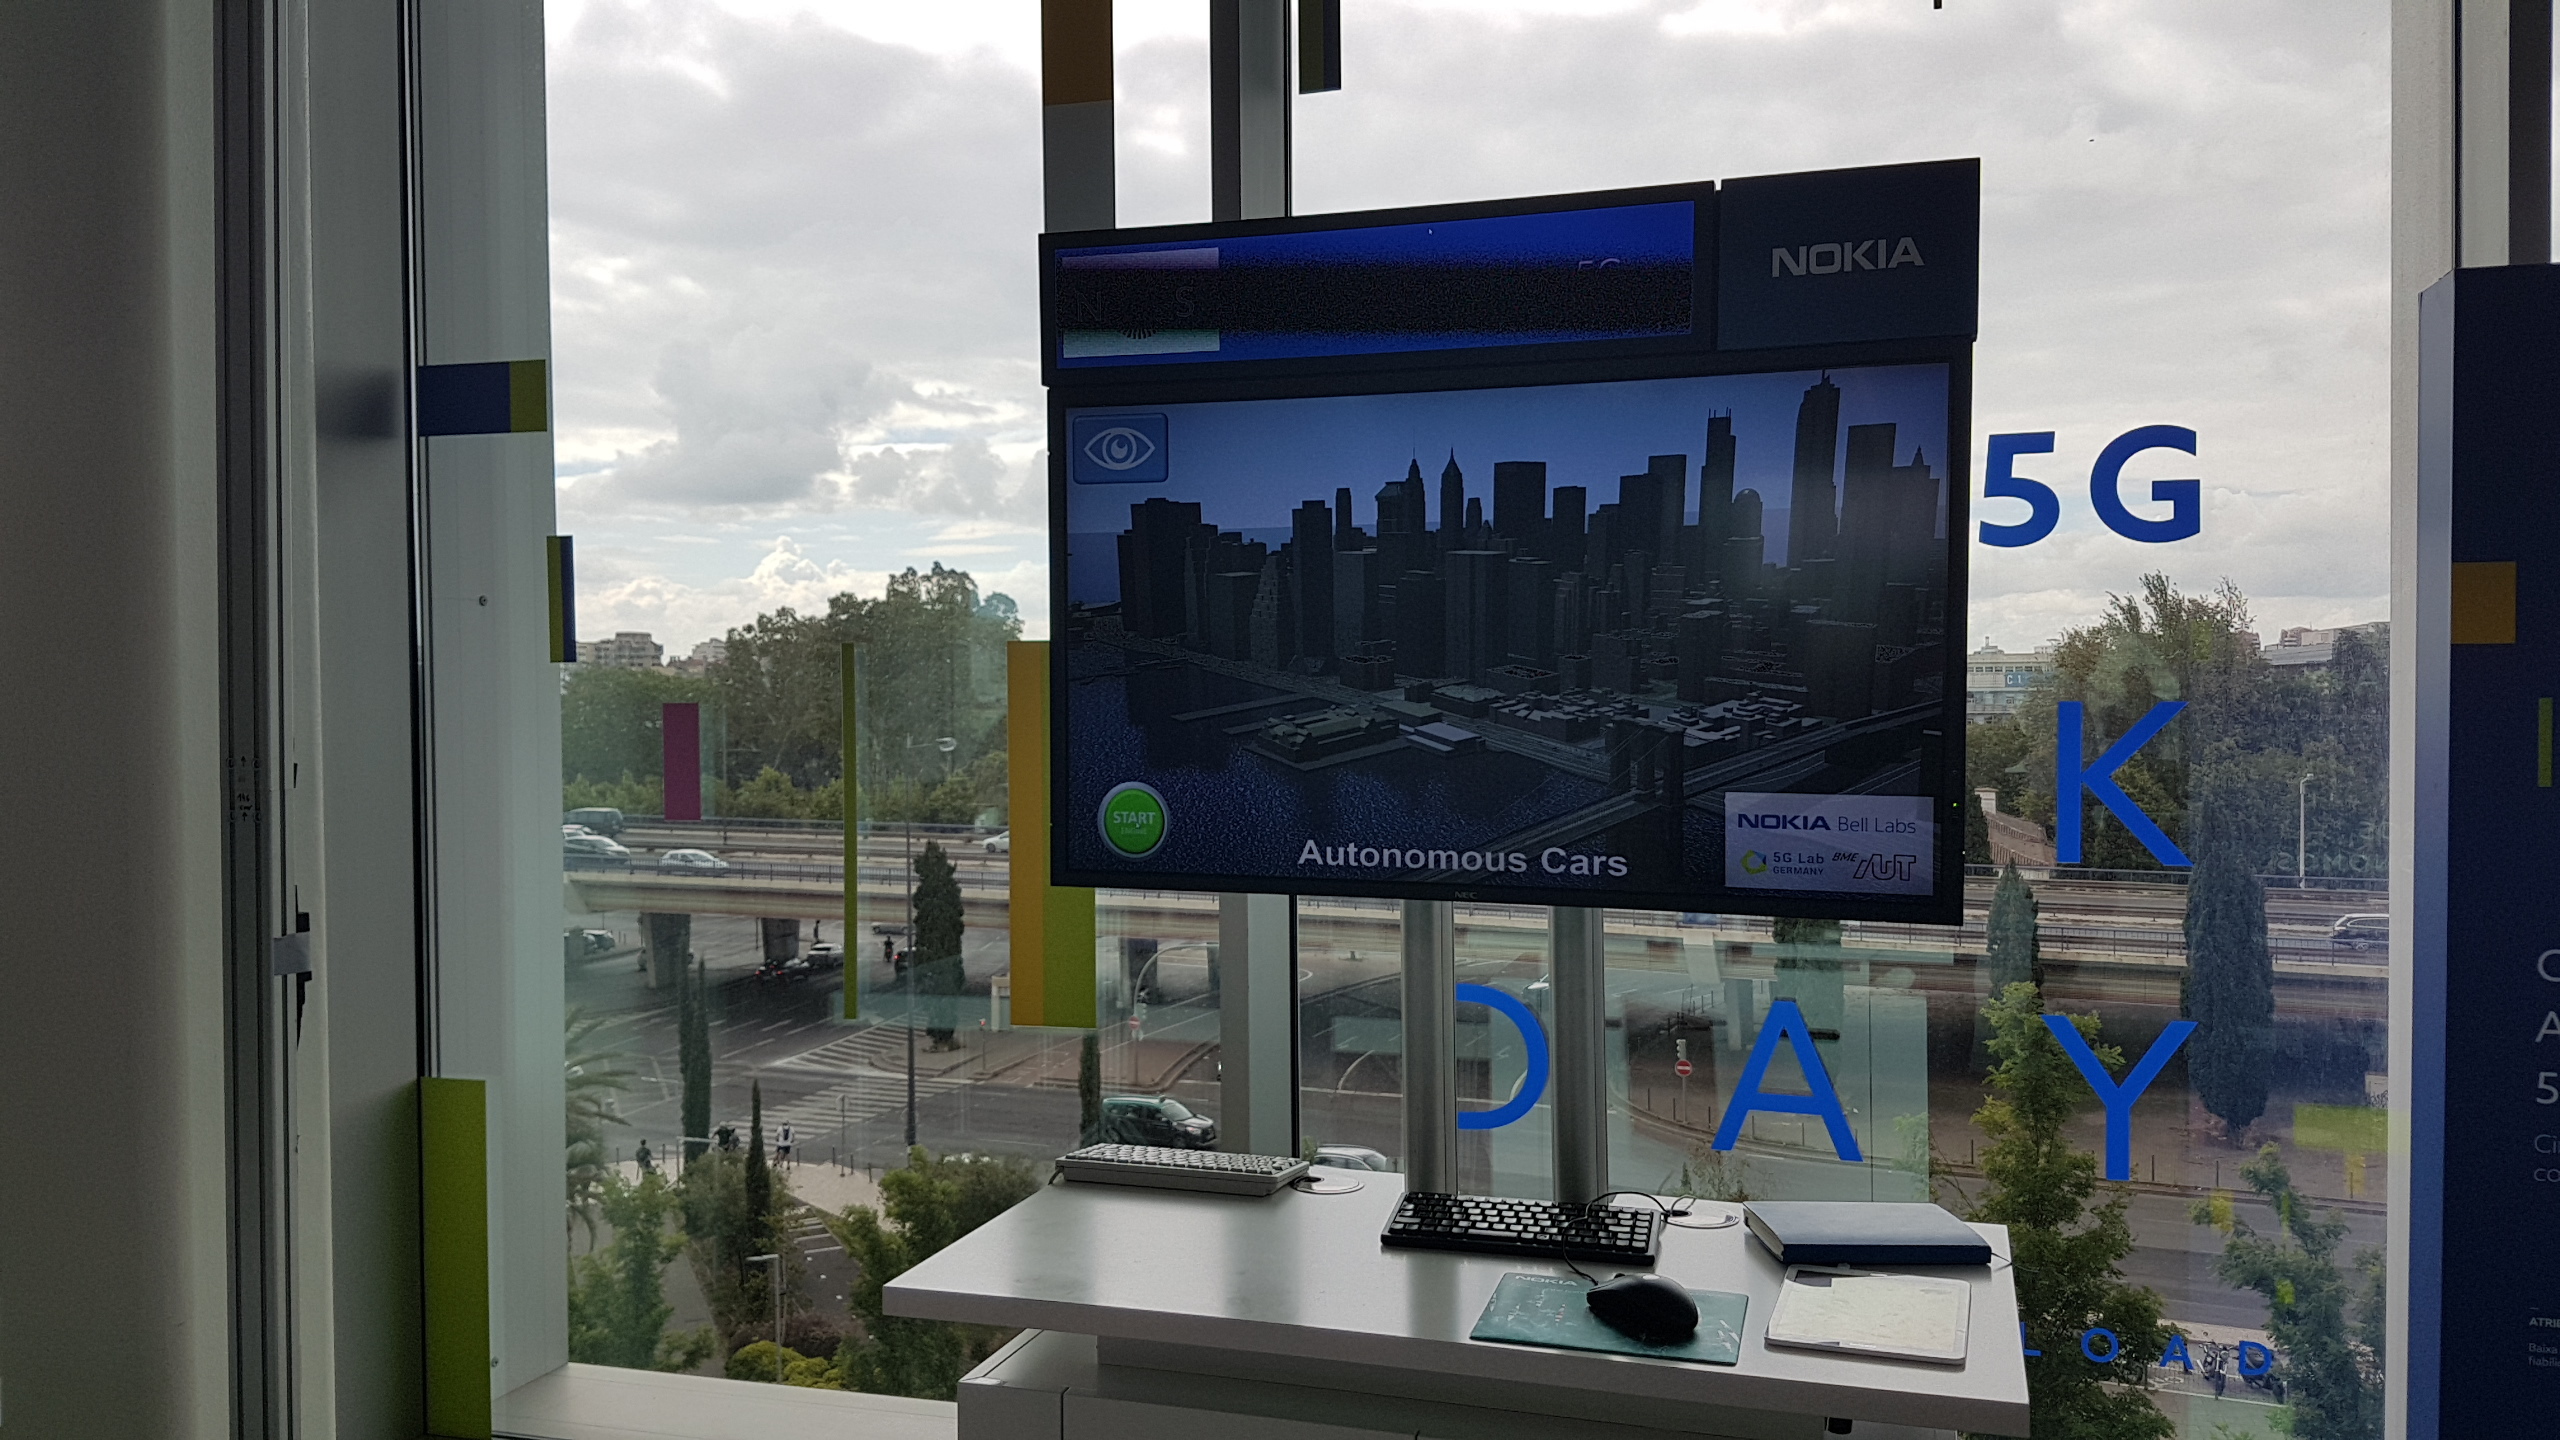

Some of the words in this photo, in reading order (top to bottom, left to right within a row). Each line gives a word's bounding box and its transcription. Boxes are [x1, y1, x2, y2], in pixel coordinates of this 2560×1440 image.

[1772, 236, 1925, 278] NOKIA
[1977, 424, 2202, 548] 5G
[2055, 700, 2195, 869] K
[1113, 810, 1156, 824] START
[1737, 813, 1831, 831] NOKIA
[1838, 815, 1869, 833] Bell
[1875, 818, 1917, 834] Labs
[1297, 839, 1528, 874] Autonomous
[1541, 846, 1629, 877] Cars
[1773, 851, 1793, 863] 5G
[1798, 852, 1825, 864] Lab
[1831, 852, 1860, 863] BME
[1772, 865, 1825, 876] GERMANY
[1454, 891, 1478, 900] NEC
[1514, 1275, 1578, 1287] NOKIA
